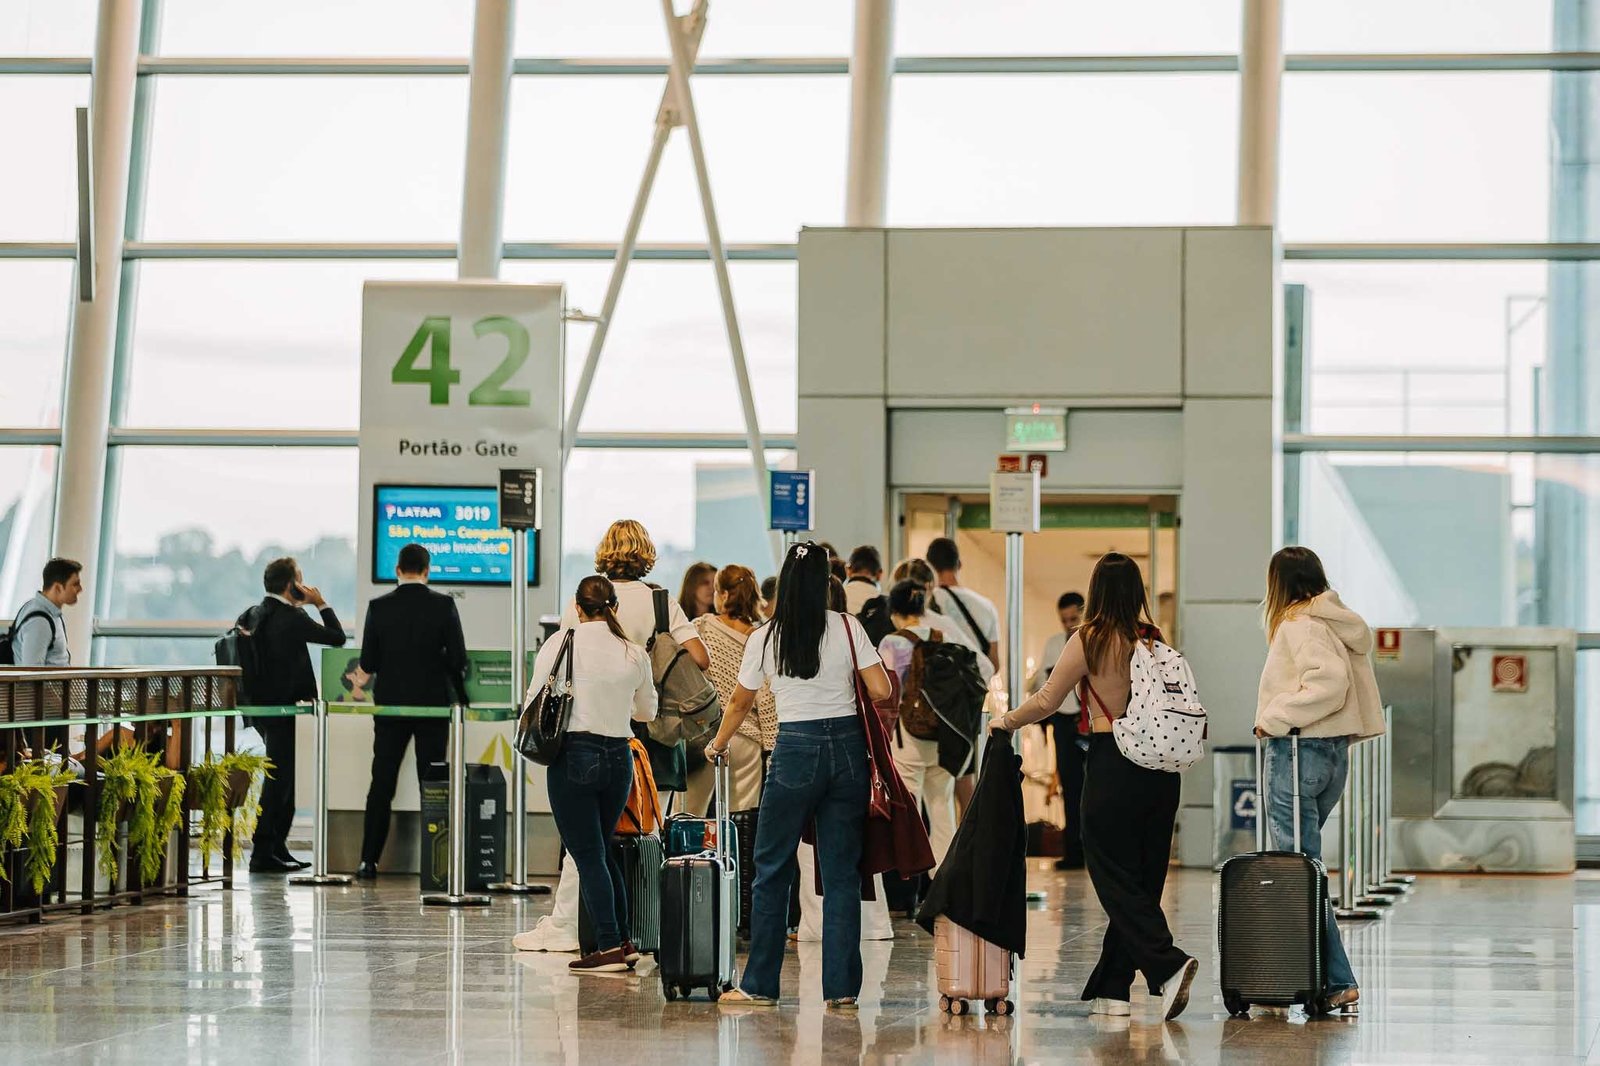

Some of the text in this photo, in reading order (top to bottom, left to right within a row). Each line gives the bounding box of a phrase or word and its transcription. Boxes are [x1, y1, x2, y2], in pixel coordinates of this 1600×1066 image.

[391, 315, 530, 406] 42
[399, 438, 518, 456] Portão Gate
[396, 506, 442, 518] LATAM
[413, 524, 446, 539] Paulo
